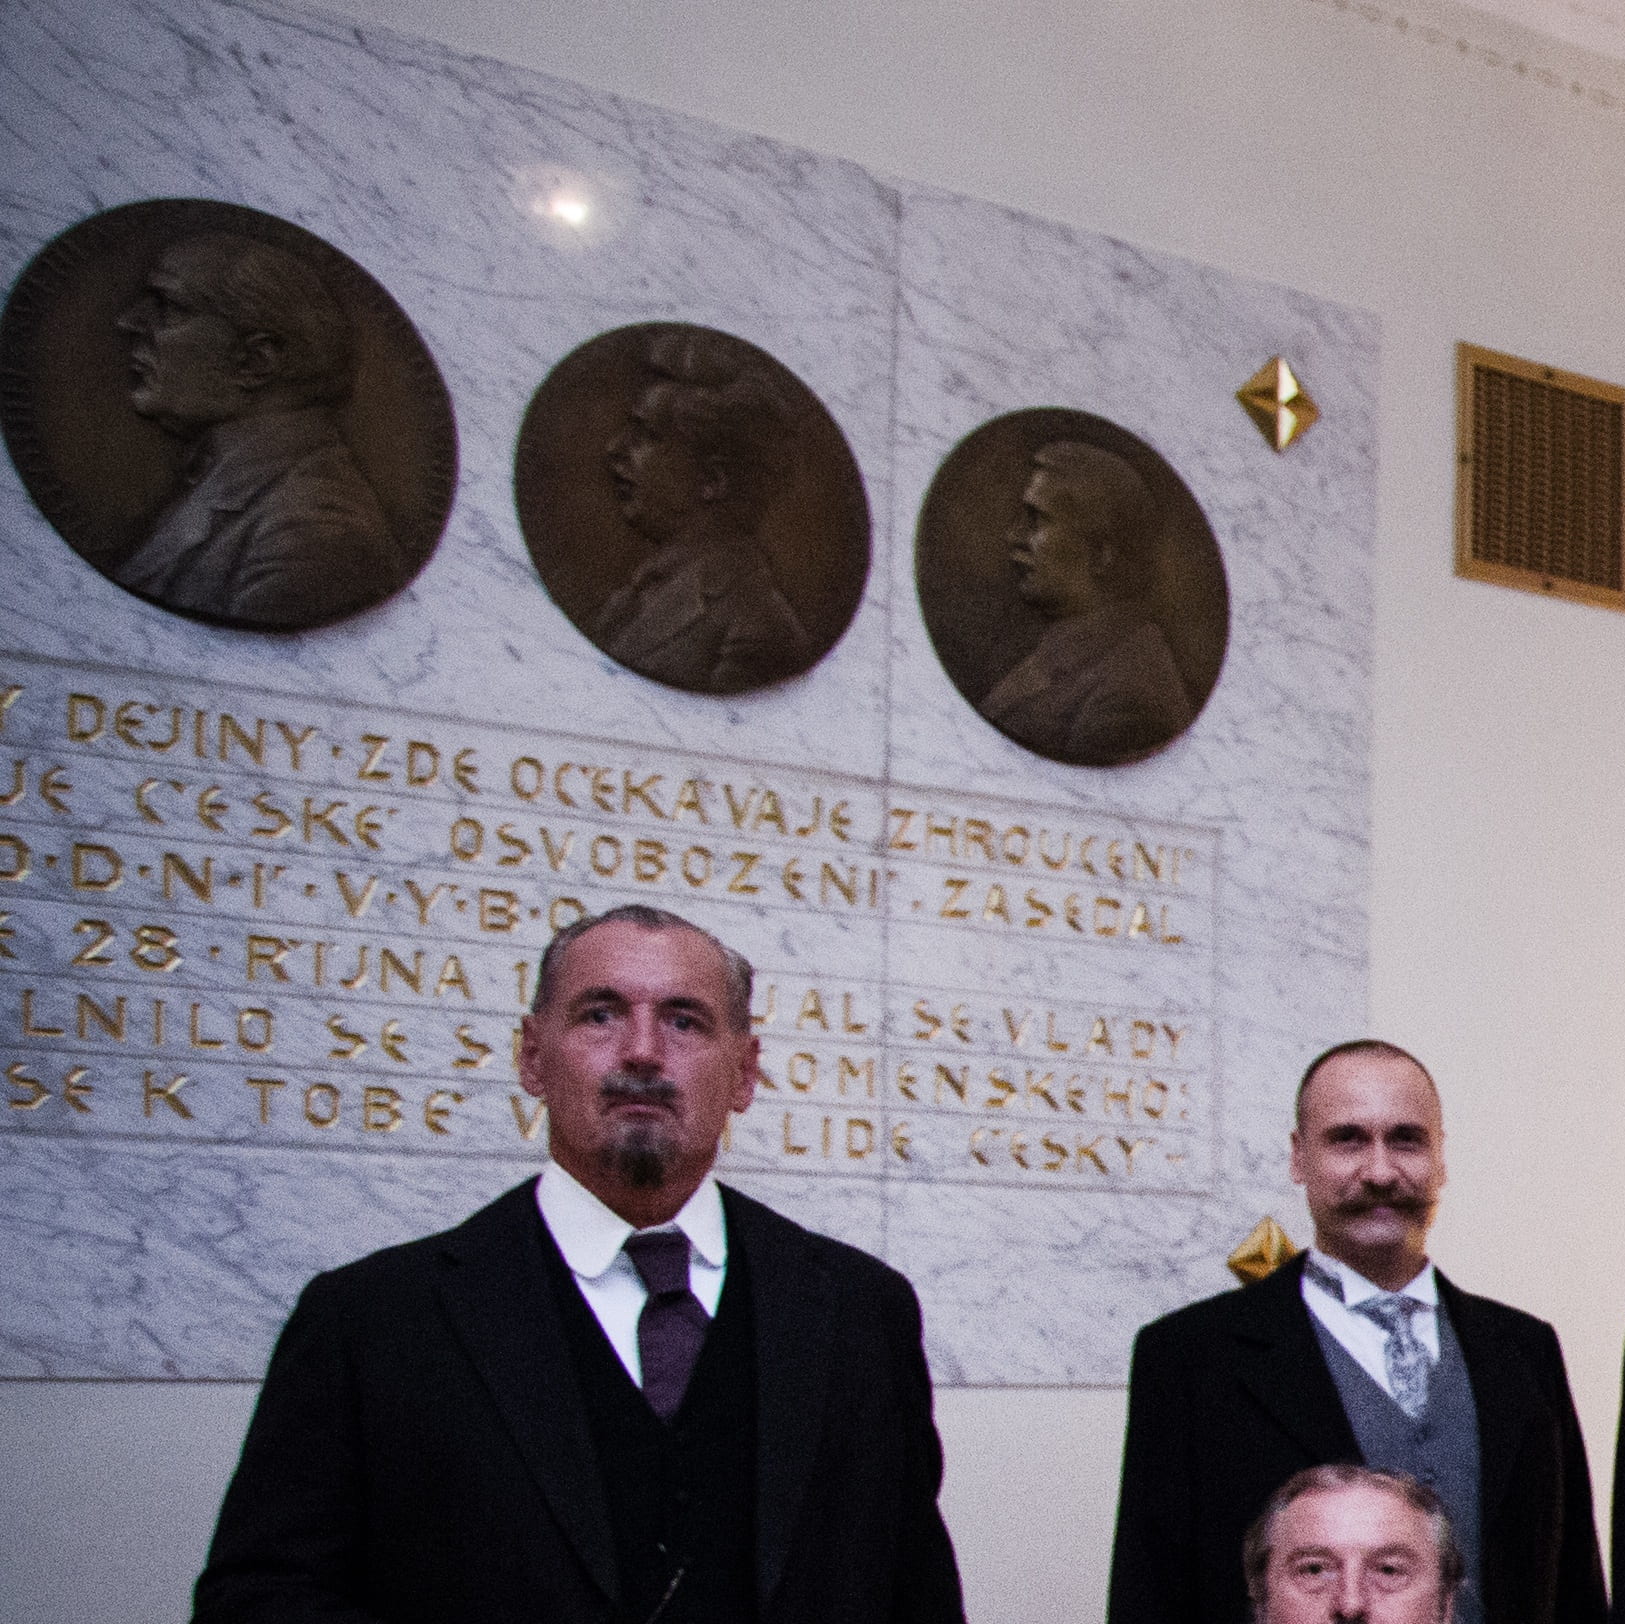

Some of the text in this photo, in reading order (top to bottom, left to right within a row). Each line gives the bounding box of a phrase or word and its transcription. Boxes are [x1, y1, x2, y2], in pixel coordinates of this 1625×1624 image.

[357, 733, 479, 795] ZDE
[939, 878, 1185, 944] ZASEDAL
[325, 1013, 409, 1064] SE
[913, 999, 972, 1044] SE
[5, 1061, 92, 1114] SE
[142, 1070, 194, 1121] K
[783, 1111, 911, 1163] LIDE
